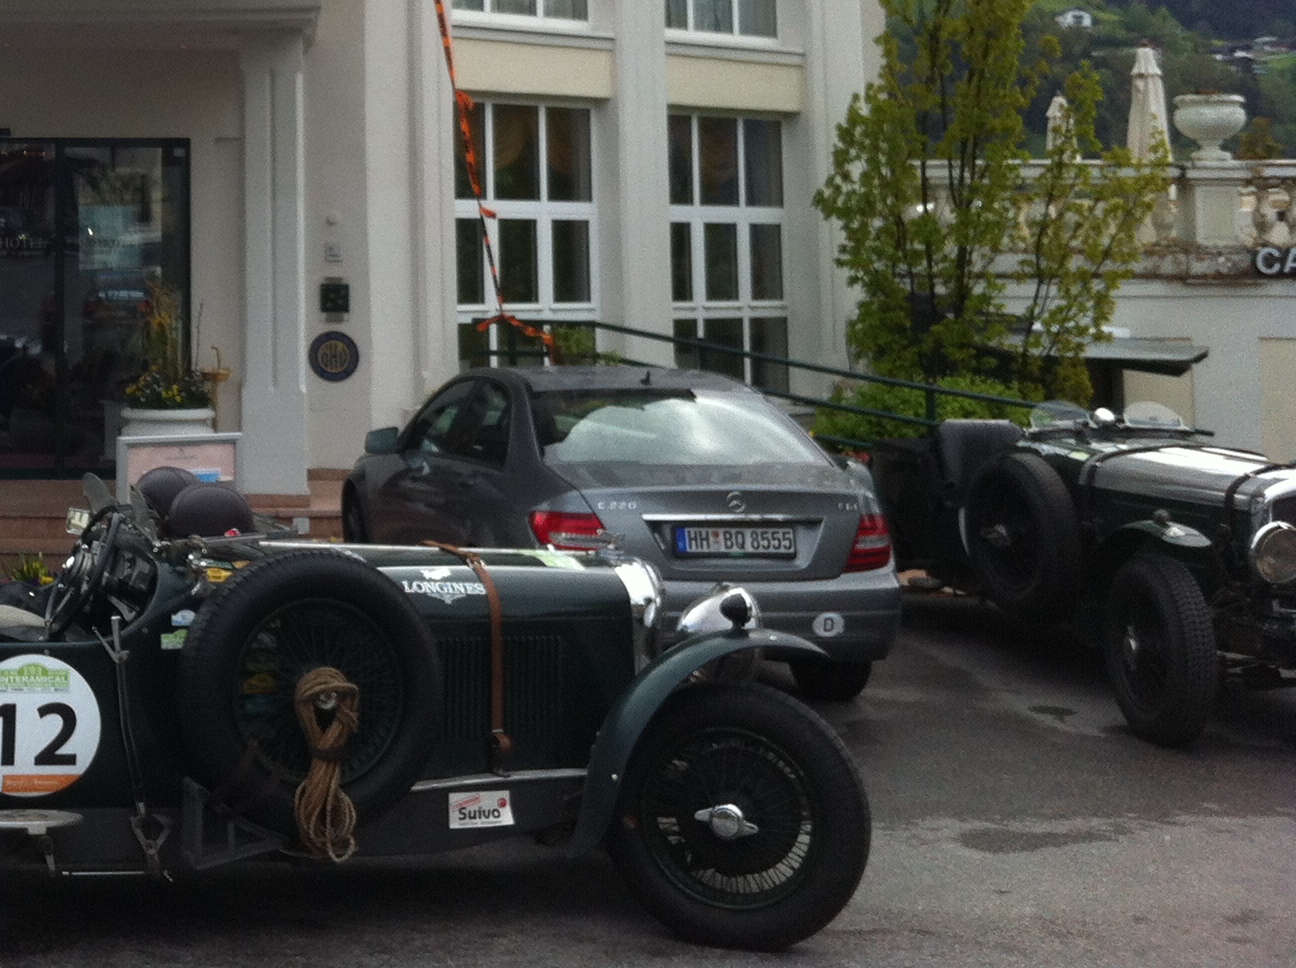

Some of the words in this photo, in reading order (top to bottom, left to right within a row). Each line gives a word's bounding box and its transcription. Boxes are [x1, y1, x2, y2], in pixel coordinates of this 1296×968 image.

[687, 530, 710, 550] HH
[723, 530, 746, 550] BQ
[750, 530, 794, 551] 8555
[401, 580, 488, 595] LONGINES
[823, 617, 835, 633] D
[458, 806, 501, 821] Suivo
